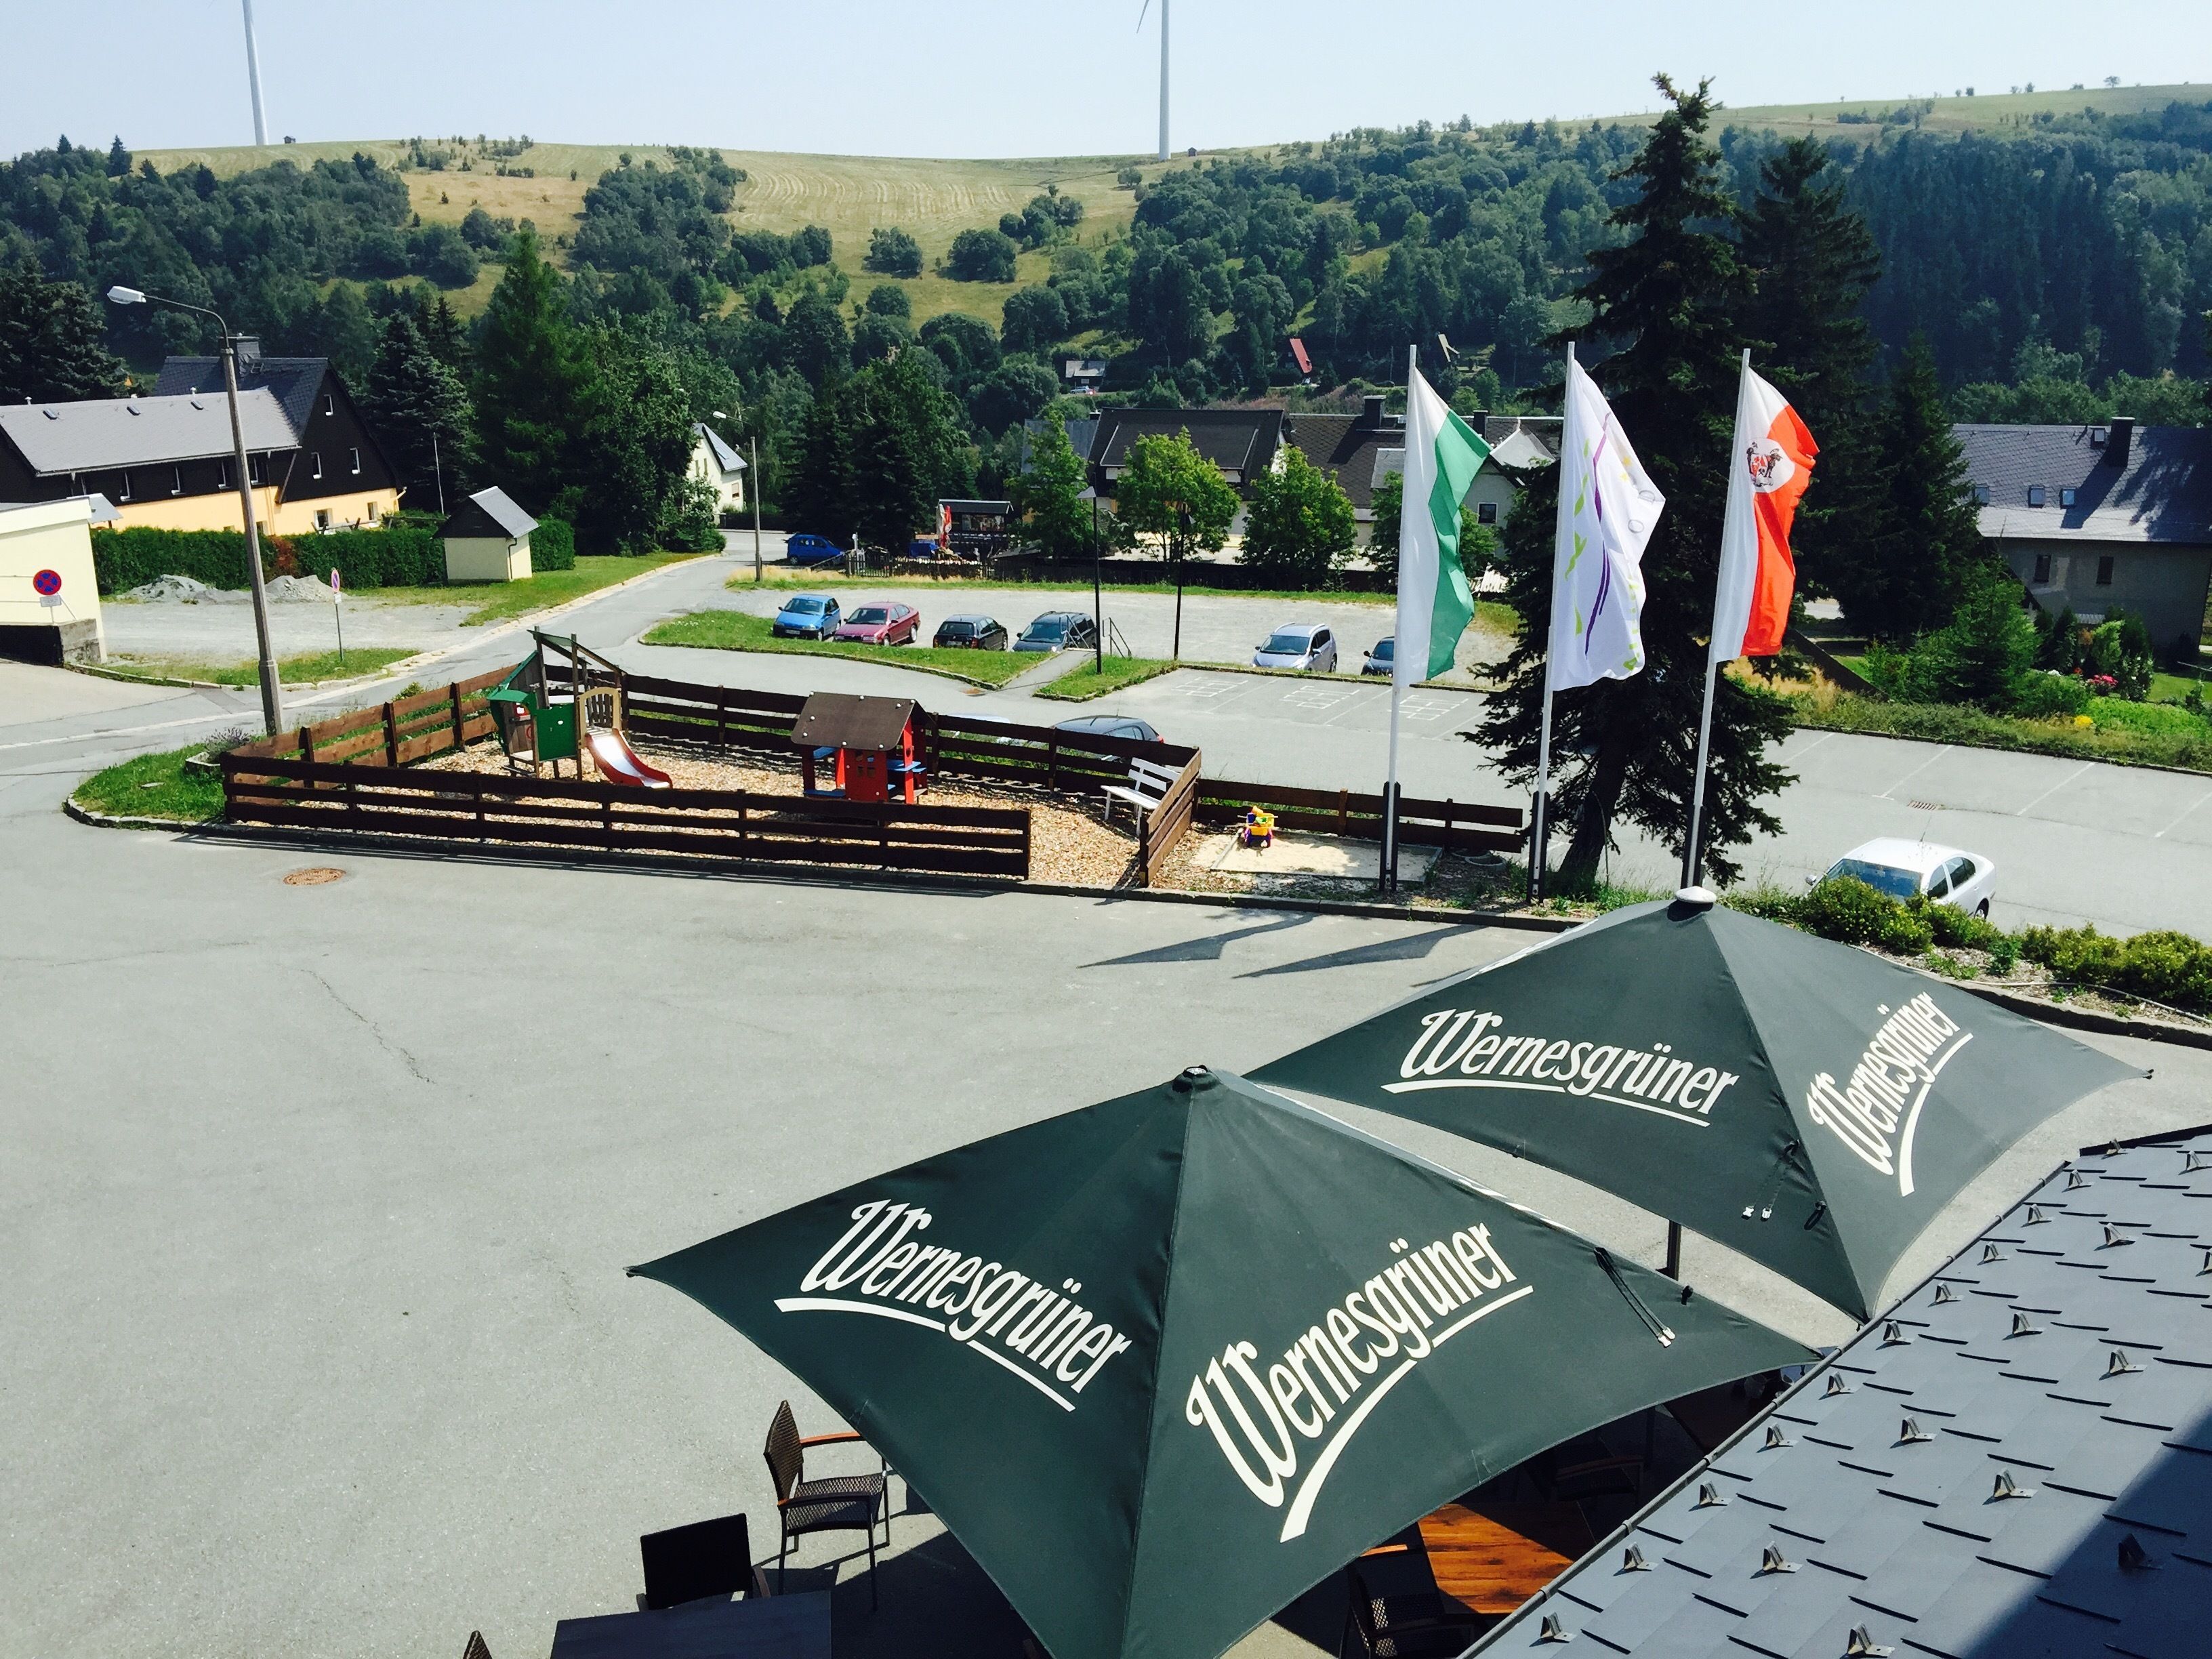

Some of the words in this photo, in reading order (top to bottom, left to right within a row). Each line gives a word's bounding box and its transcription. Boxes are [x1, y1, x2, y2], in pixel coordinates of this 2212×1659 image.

[1171, 677, 1248, 697] JEEP
[1278, 685, 1360, 710] JEEP
[1400, 1008, 1739, 1114] Wernesgrüner
[1805, 991, 1961, 1175] Wernesgrüner
[800, 1199, 1132, 1394] Wernesgrüner
[1185, 1222, 1517, 1507] Wernesgrüner
